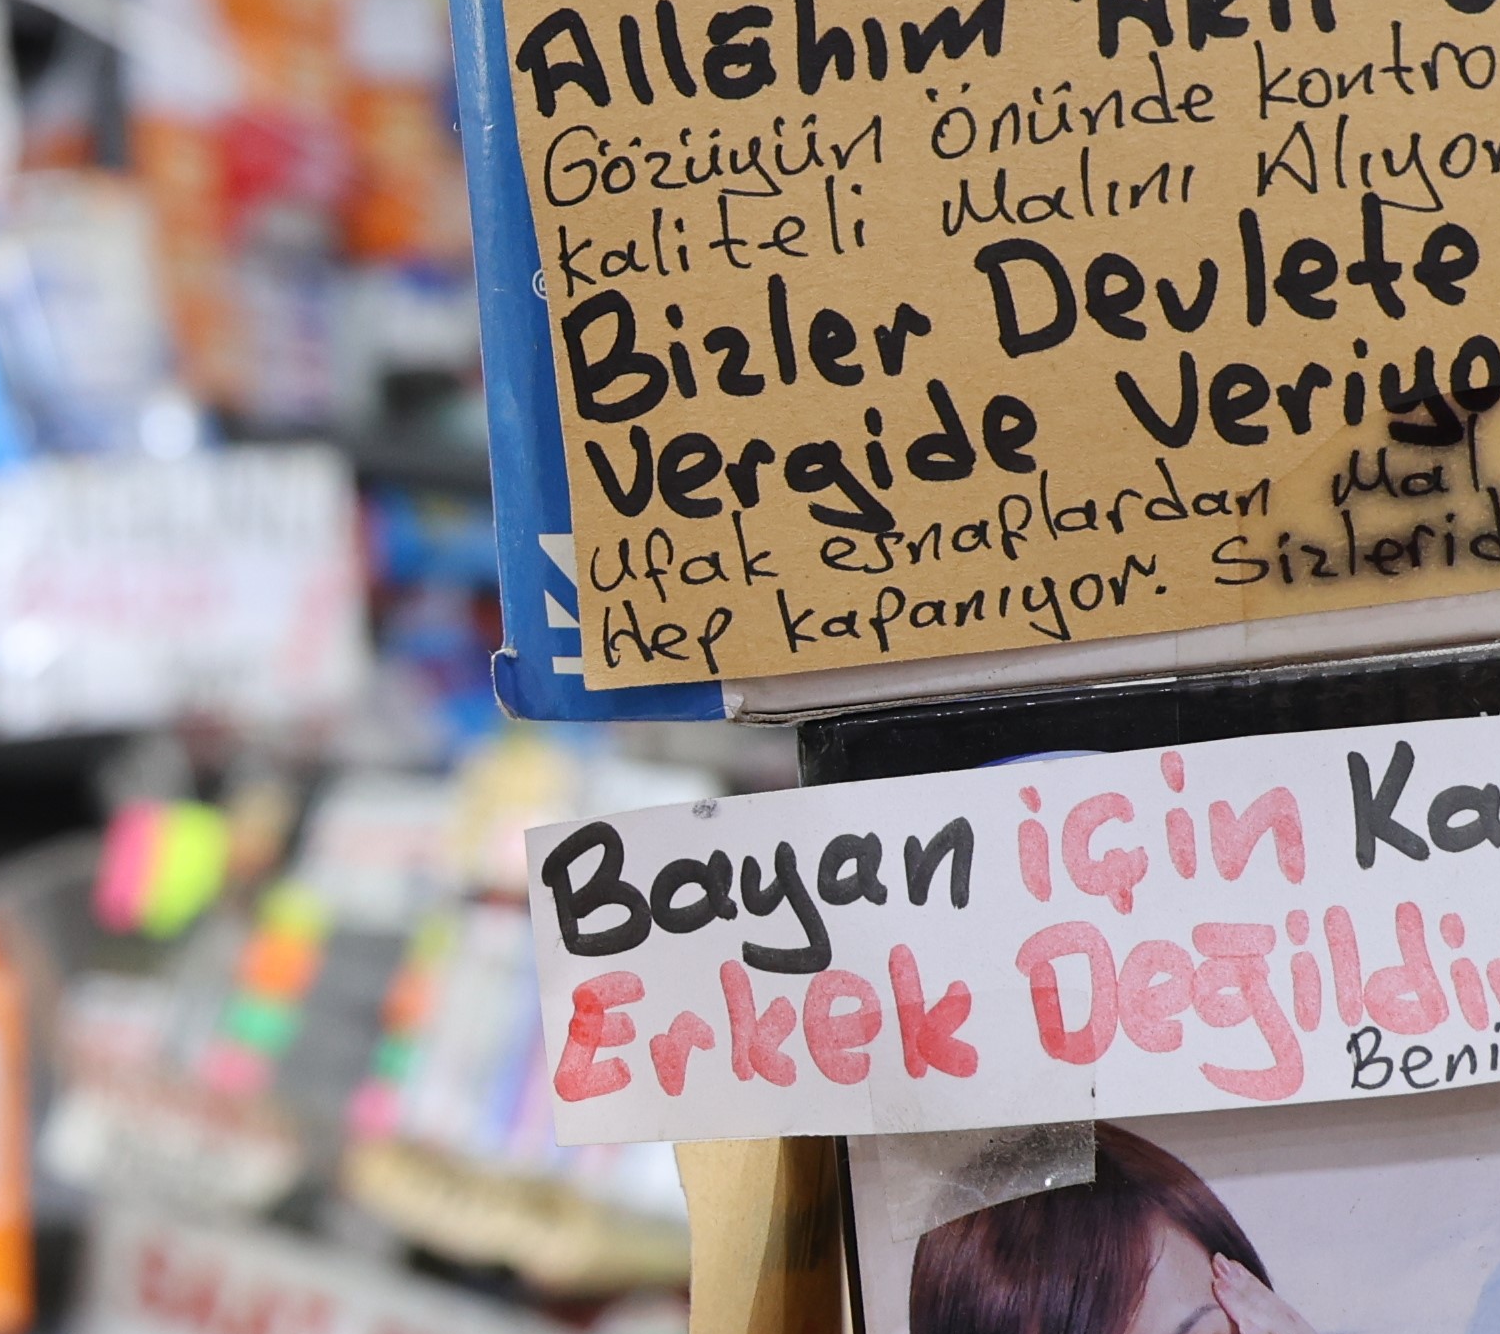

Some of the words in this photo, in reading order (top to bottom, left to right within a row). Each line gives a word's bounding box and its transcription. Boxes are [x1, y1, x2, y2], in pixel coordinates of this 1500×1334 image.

[560, 273, 933, 425] Bizler
[974, 191, 1480, 360] Devlete
[1331, 413, 1487, 508] Mal
[602, 603, 734, 676] Hep
[540, 819, 975, 975] Bayan
[552, 942, 980, 1104] Erkek
